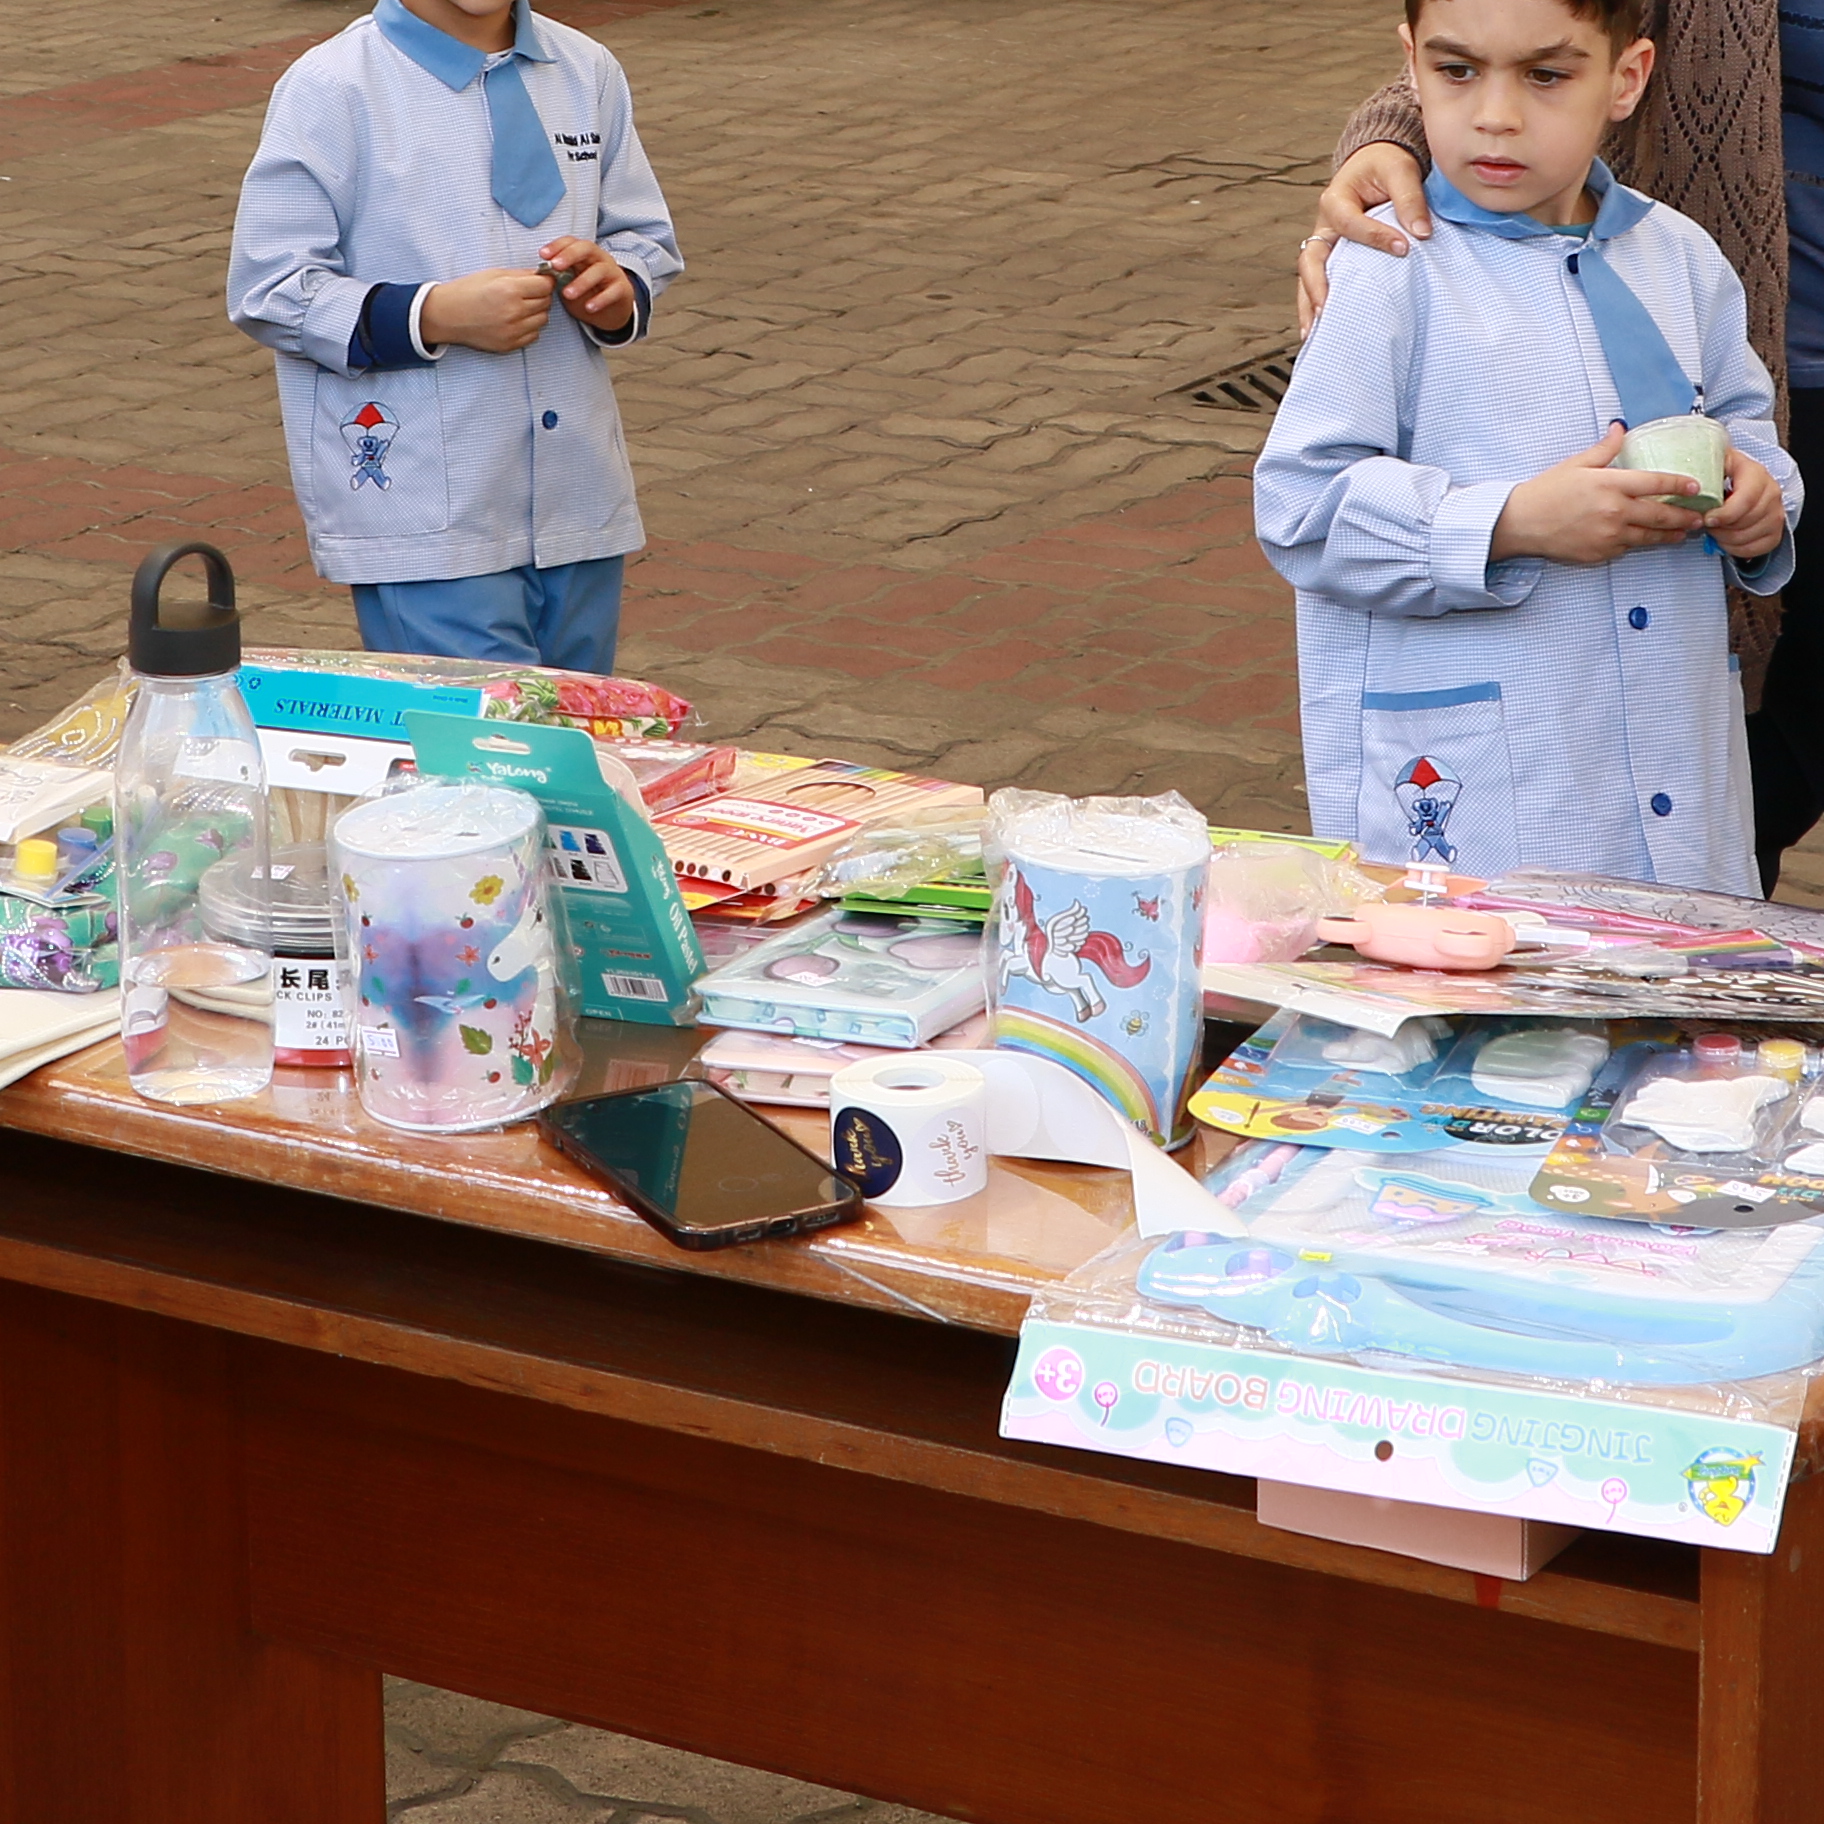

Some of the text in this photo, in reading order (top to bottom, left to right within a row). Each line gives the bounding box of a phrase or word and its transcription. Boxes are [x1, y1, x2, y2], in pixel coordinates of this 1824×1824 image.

[274, 697, 407, 726] T MATERIALS
[668, 902, 700, 975] Oil Pastel
[280, 967, 340, 991] 长尾
[296, 992, 333, 1002] CLIPS
[315, 1036, 329, 1045] 24
[956, 1128, 979, 1161] you
[1468, 1121, 1563, 1141] OLOR
[929, 1133, 966, 1188] thank
[1036, 1355, 1080, 1394] 3+
[1133, 1357, 1654, 1464] JINGJING DRAWING BOARD
